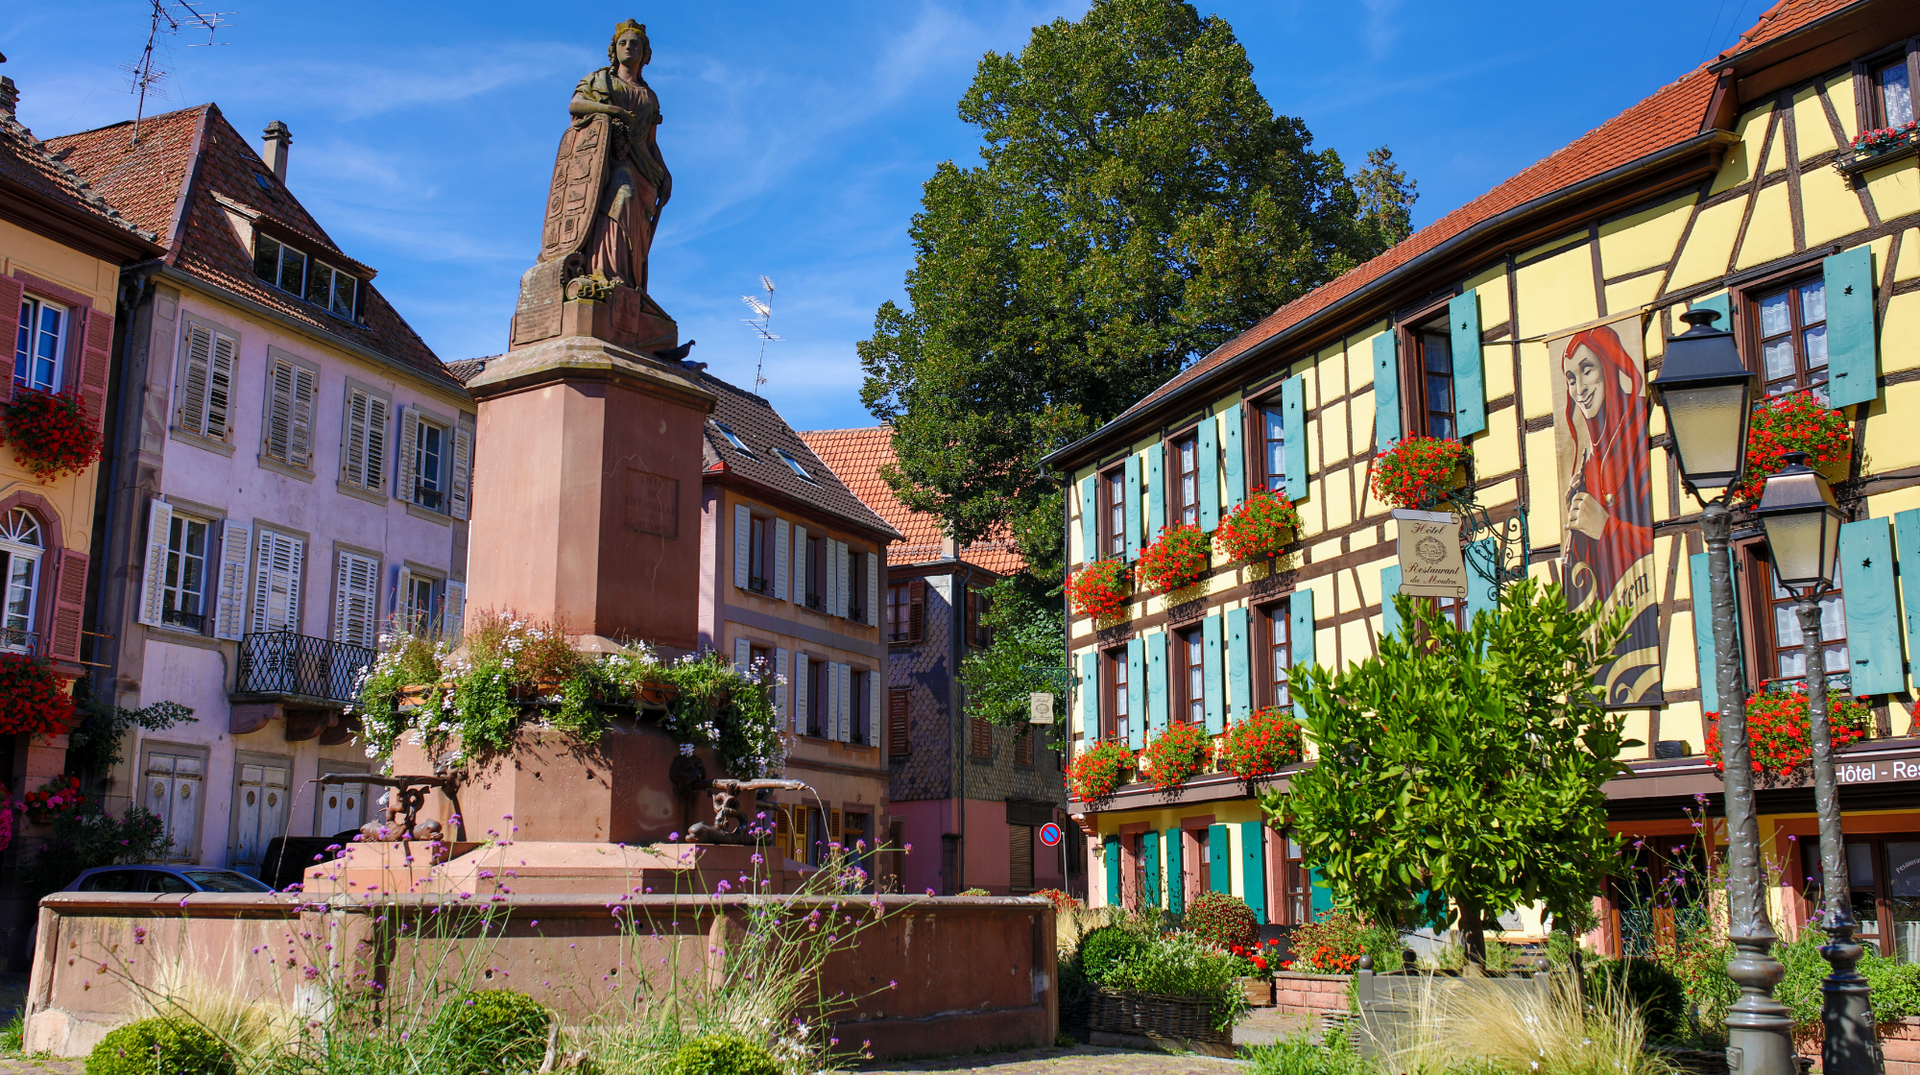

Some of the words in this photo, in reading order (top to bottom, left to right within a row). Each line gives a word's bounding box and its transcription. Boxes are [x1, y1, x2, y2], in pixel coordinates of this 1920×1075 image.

[1411, 523, 1447, 535] Hôtel
[1405, 562, 1460, 574] Restaurant
[1423, 575, 1457, 584] Mouton
[1835, 763, 1876, 782] Hôtel
[1893, 761, 1920, 779] Re
